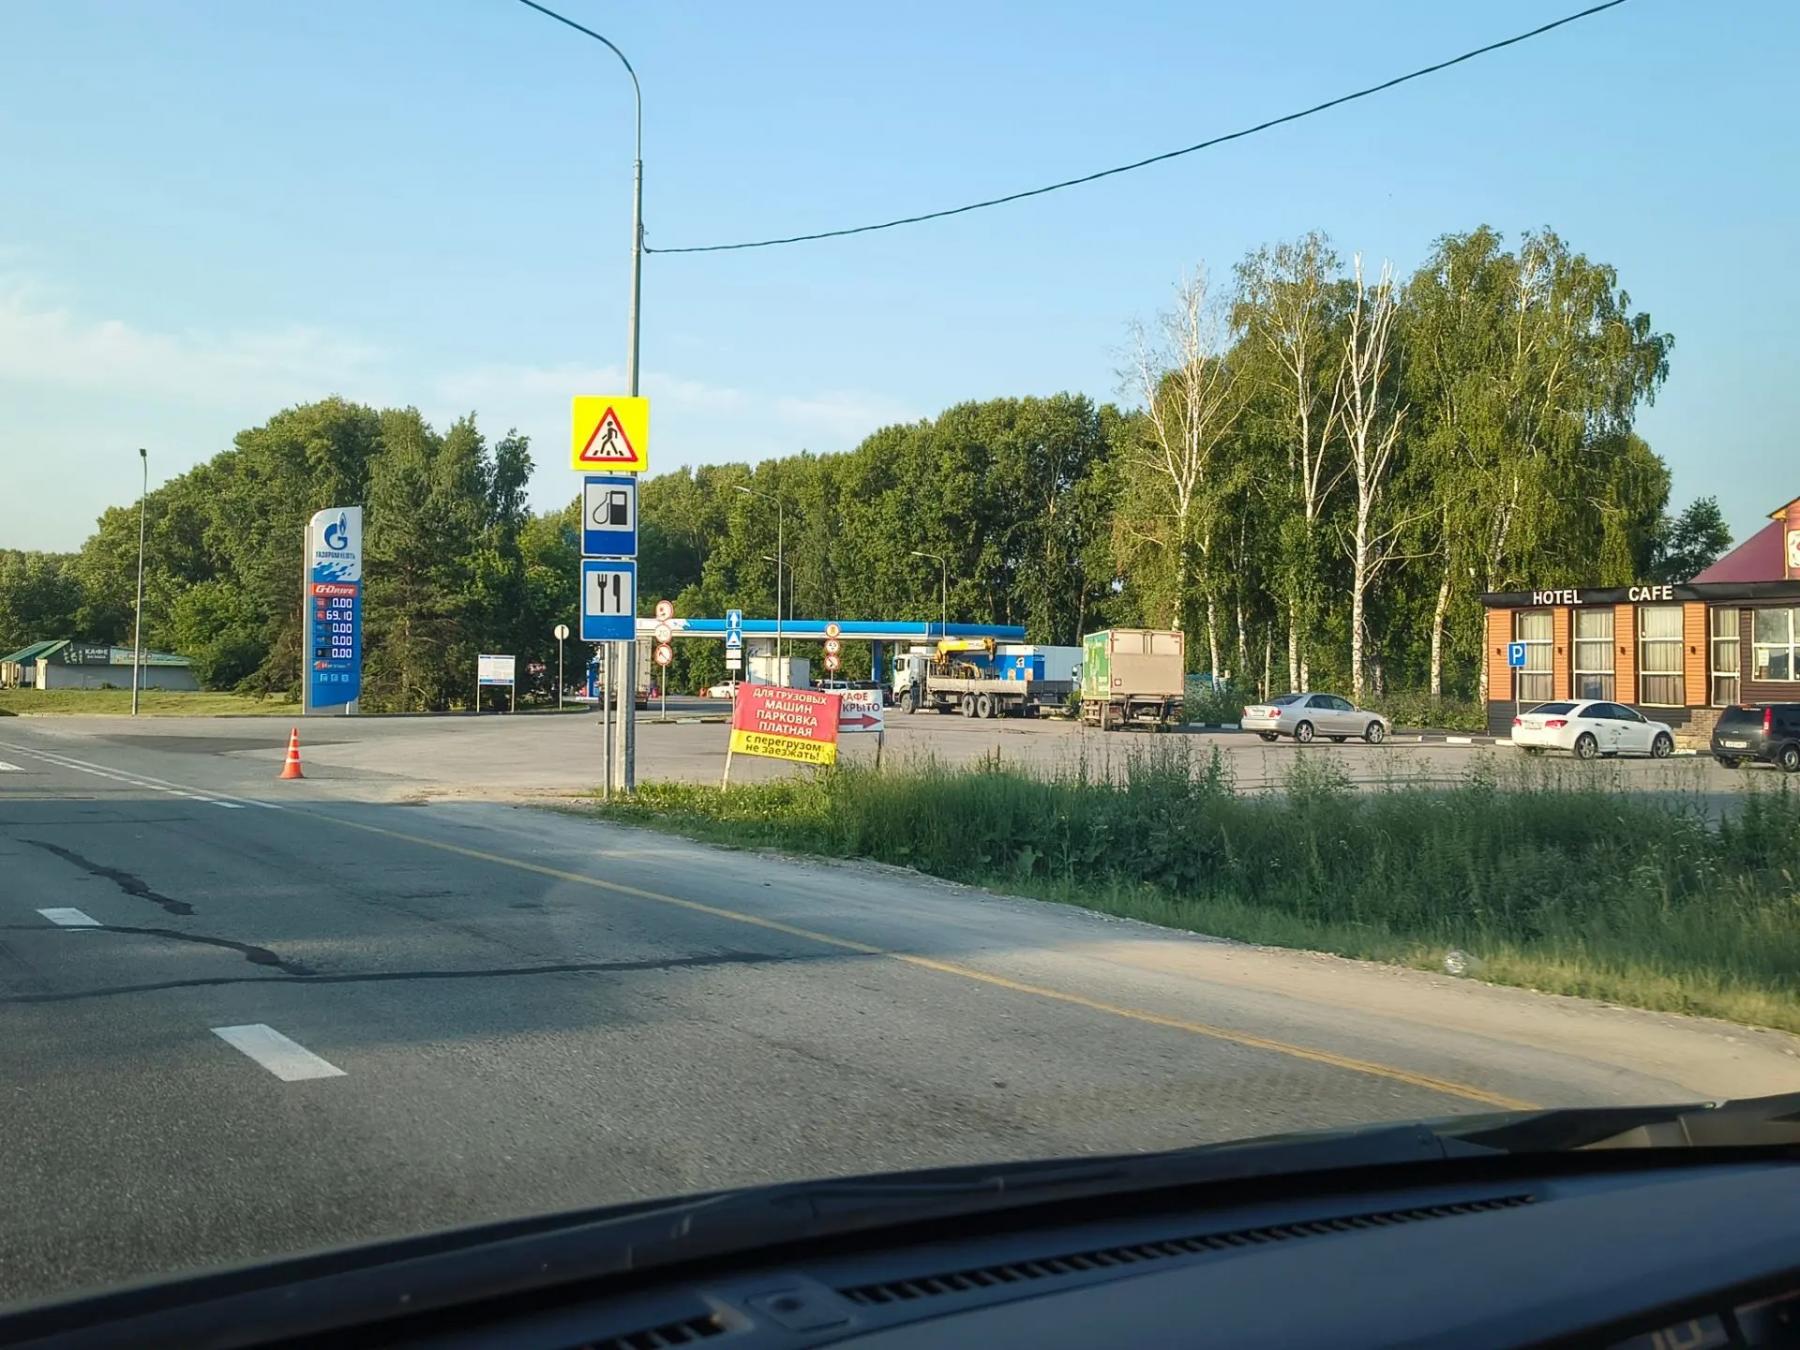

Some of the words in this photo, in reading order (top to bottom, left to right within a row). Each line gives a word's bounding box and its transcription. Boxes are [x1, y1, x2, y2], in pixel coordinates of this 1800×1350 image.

[1533, 589, 1583, 605] HOTEL
[1628, 585, 1673, 602] CAFE
[332, 598, 353, 609] 0.00
[326, 611, 353, 621] 69.10
[332, 623, 353, 634] 0.00
[332, 635, 353, 646] 0.00
[332, 648, 352, 659] 0.00
[1512, 645, 1523, 664] P
[753, 688, 773, 698] ДЛЯ
[776, 690, 827, 705] ГРУЗОВЫХ
[764, 699, 813, 714] МАШИН
[756, 709, 818, 727] ПАРКОВКА
[759, 721, 813, 737] ПЛАТНАЯ
[745, 744, 760, 752] не
[762, 746, 820, 761] заезжать!
